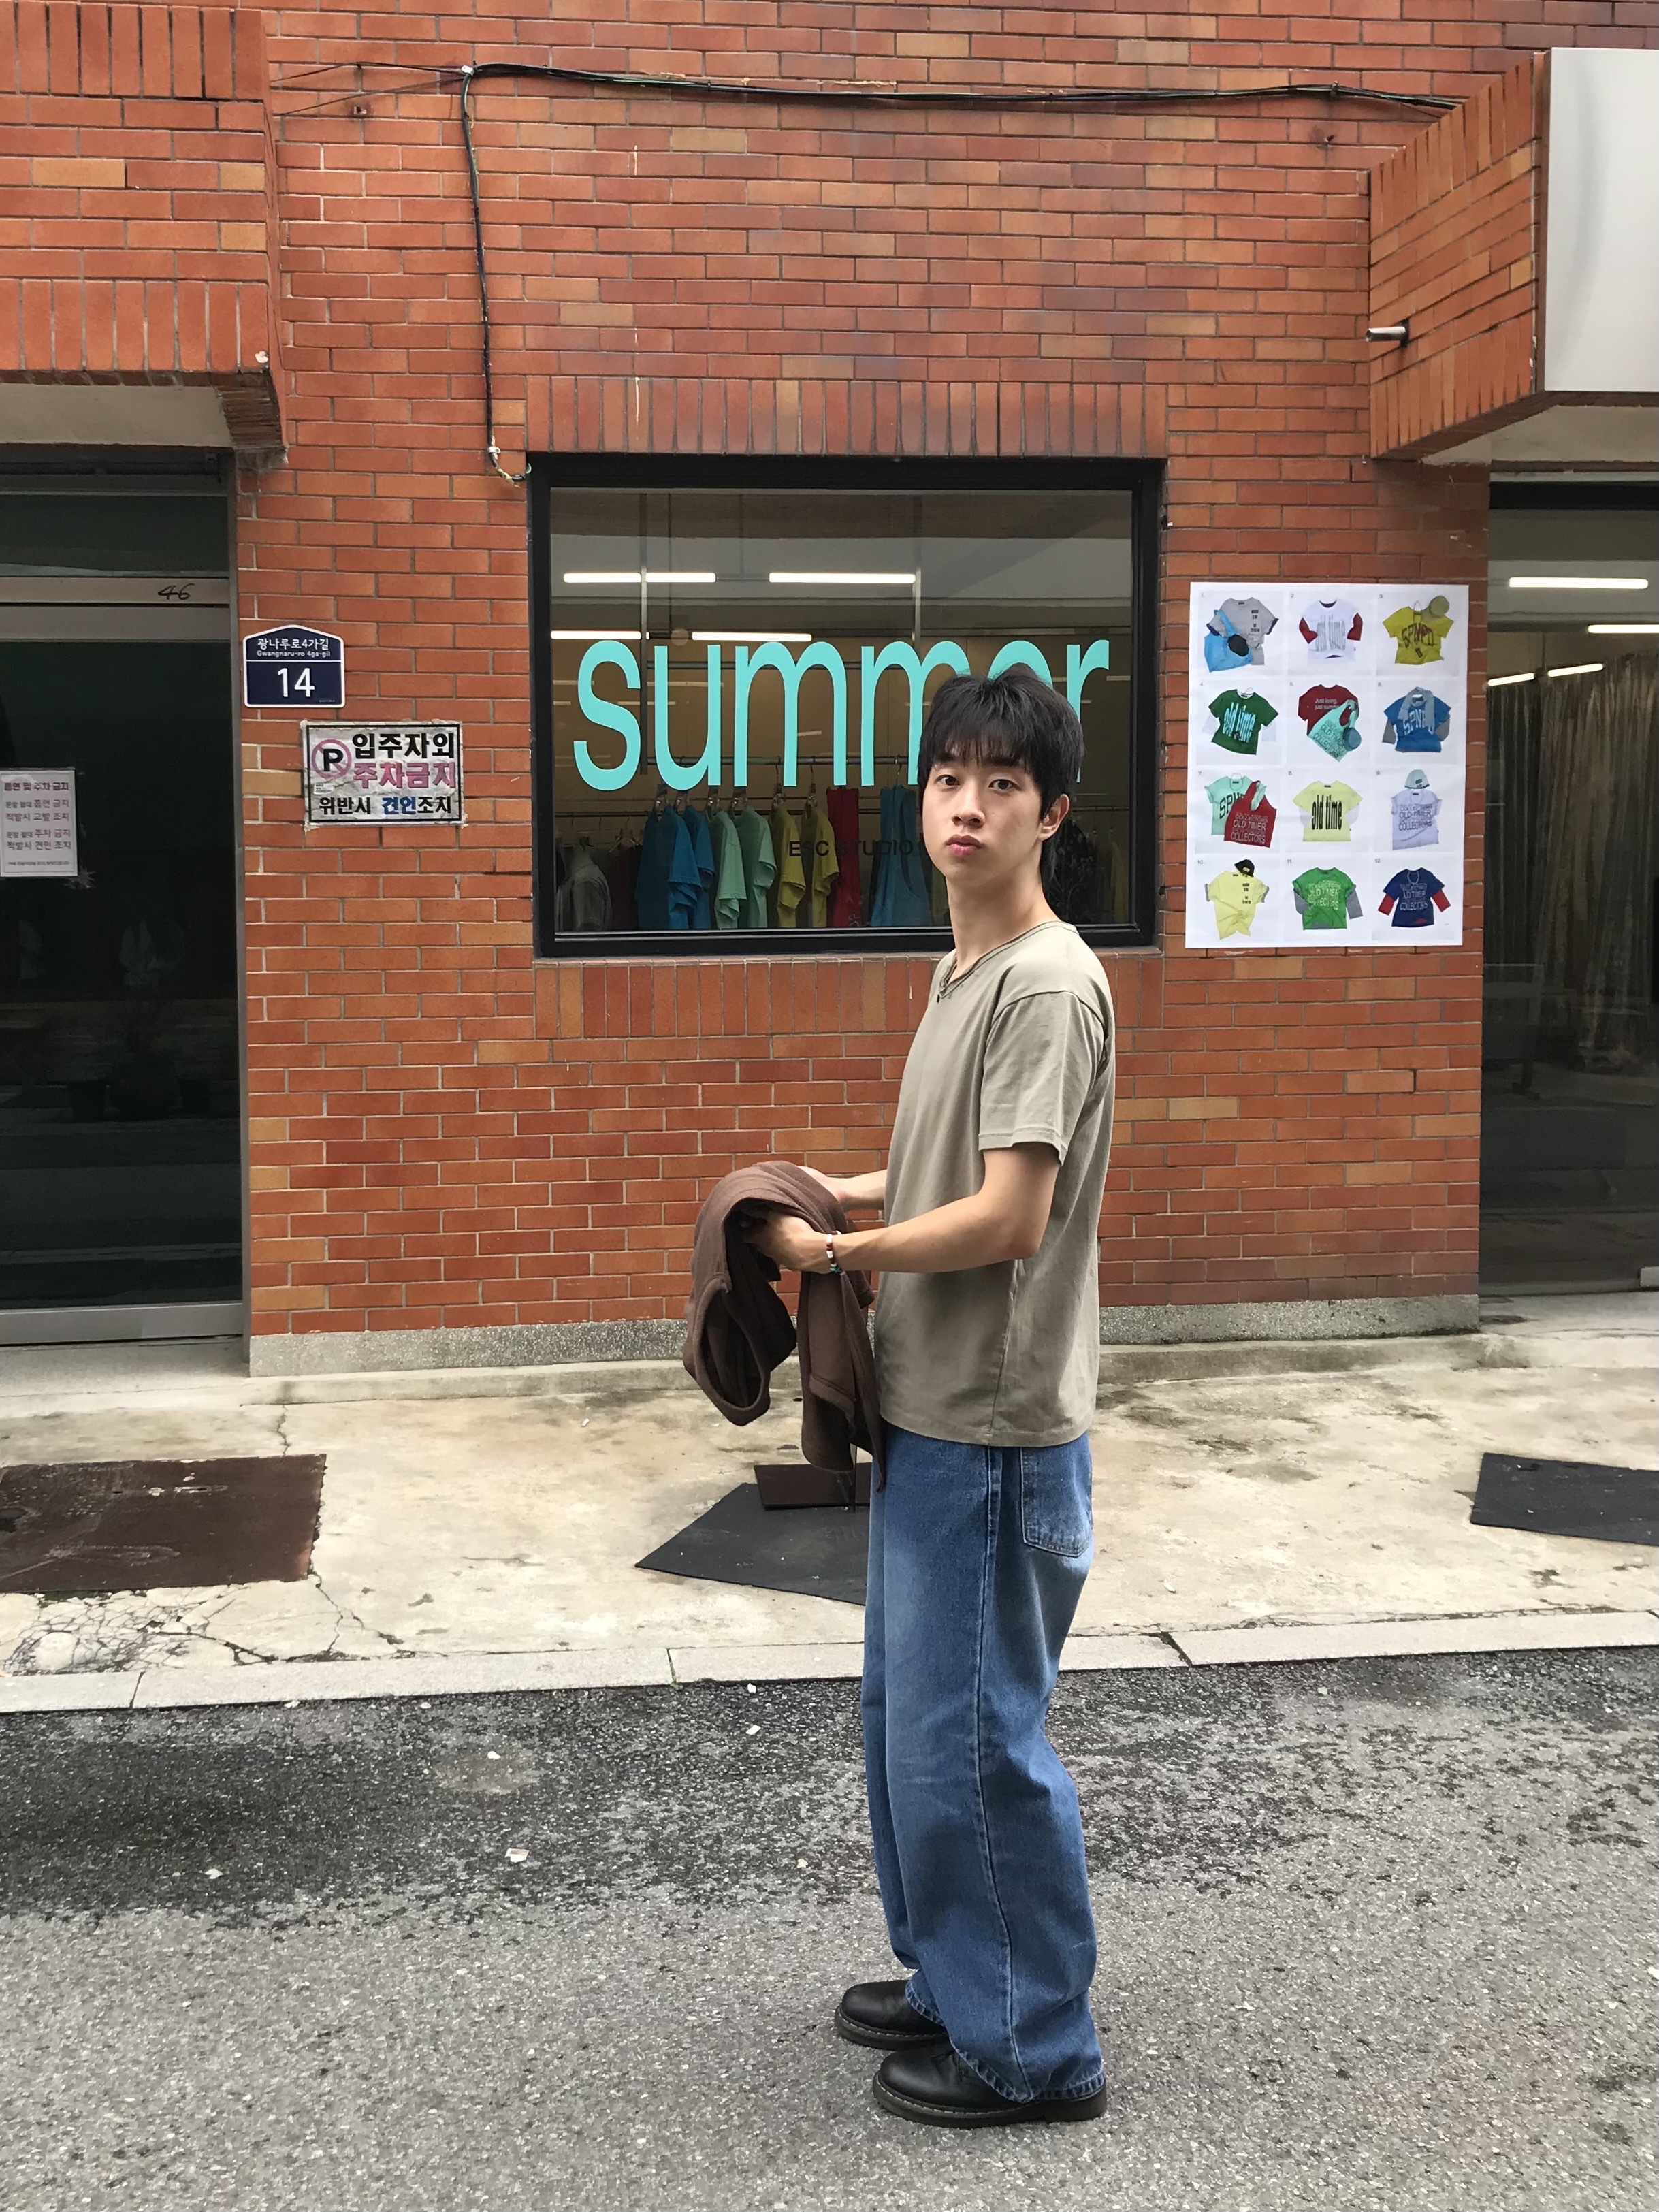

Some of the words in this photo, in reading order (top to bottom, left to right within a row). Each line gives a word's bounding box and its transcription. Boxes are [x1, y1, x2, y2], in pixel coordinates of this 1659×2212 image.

[158, 583, 195, 600] 46
[257, 638, 329, 650] 광나루로4가길
[278, 667, 315, 698] 14
[573, 639, 1110, 791] summr
[352, 733, 454, 759] 입주자외
[353, 762, 456, 788] 주차금지
[53, 799, 69, 808] 금지
[319, 797, 371, 814] 위반시
[382, 796, 451, 814] 견인조치
[1312, 795, 1324, 830] old
[1233, 819, 1246, 828] OLD
[54, 829, 71, 838] 금지
[1230, 831, 1266, 844] COLLECTORS
[789, 839, 829, 856] ESC
